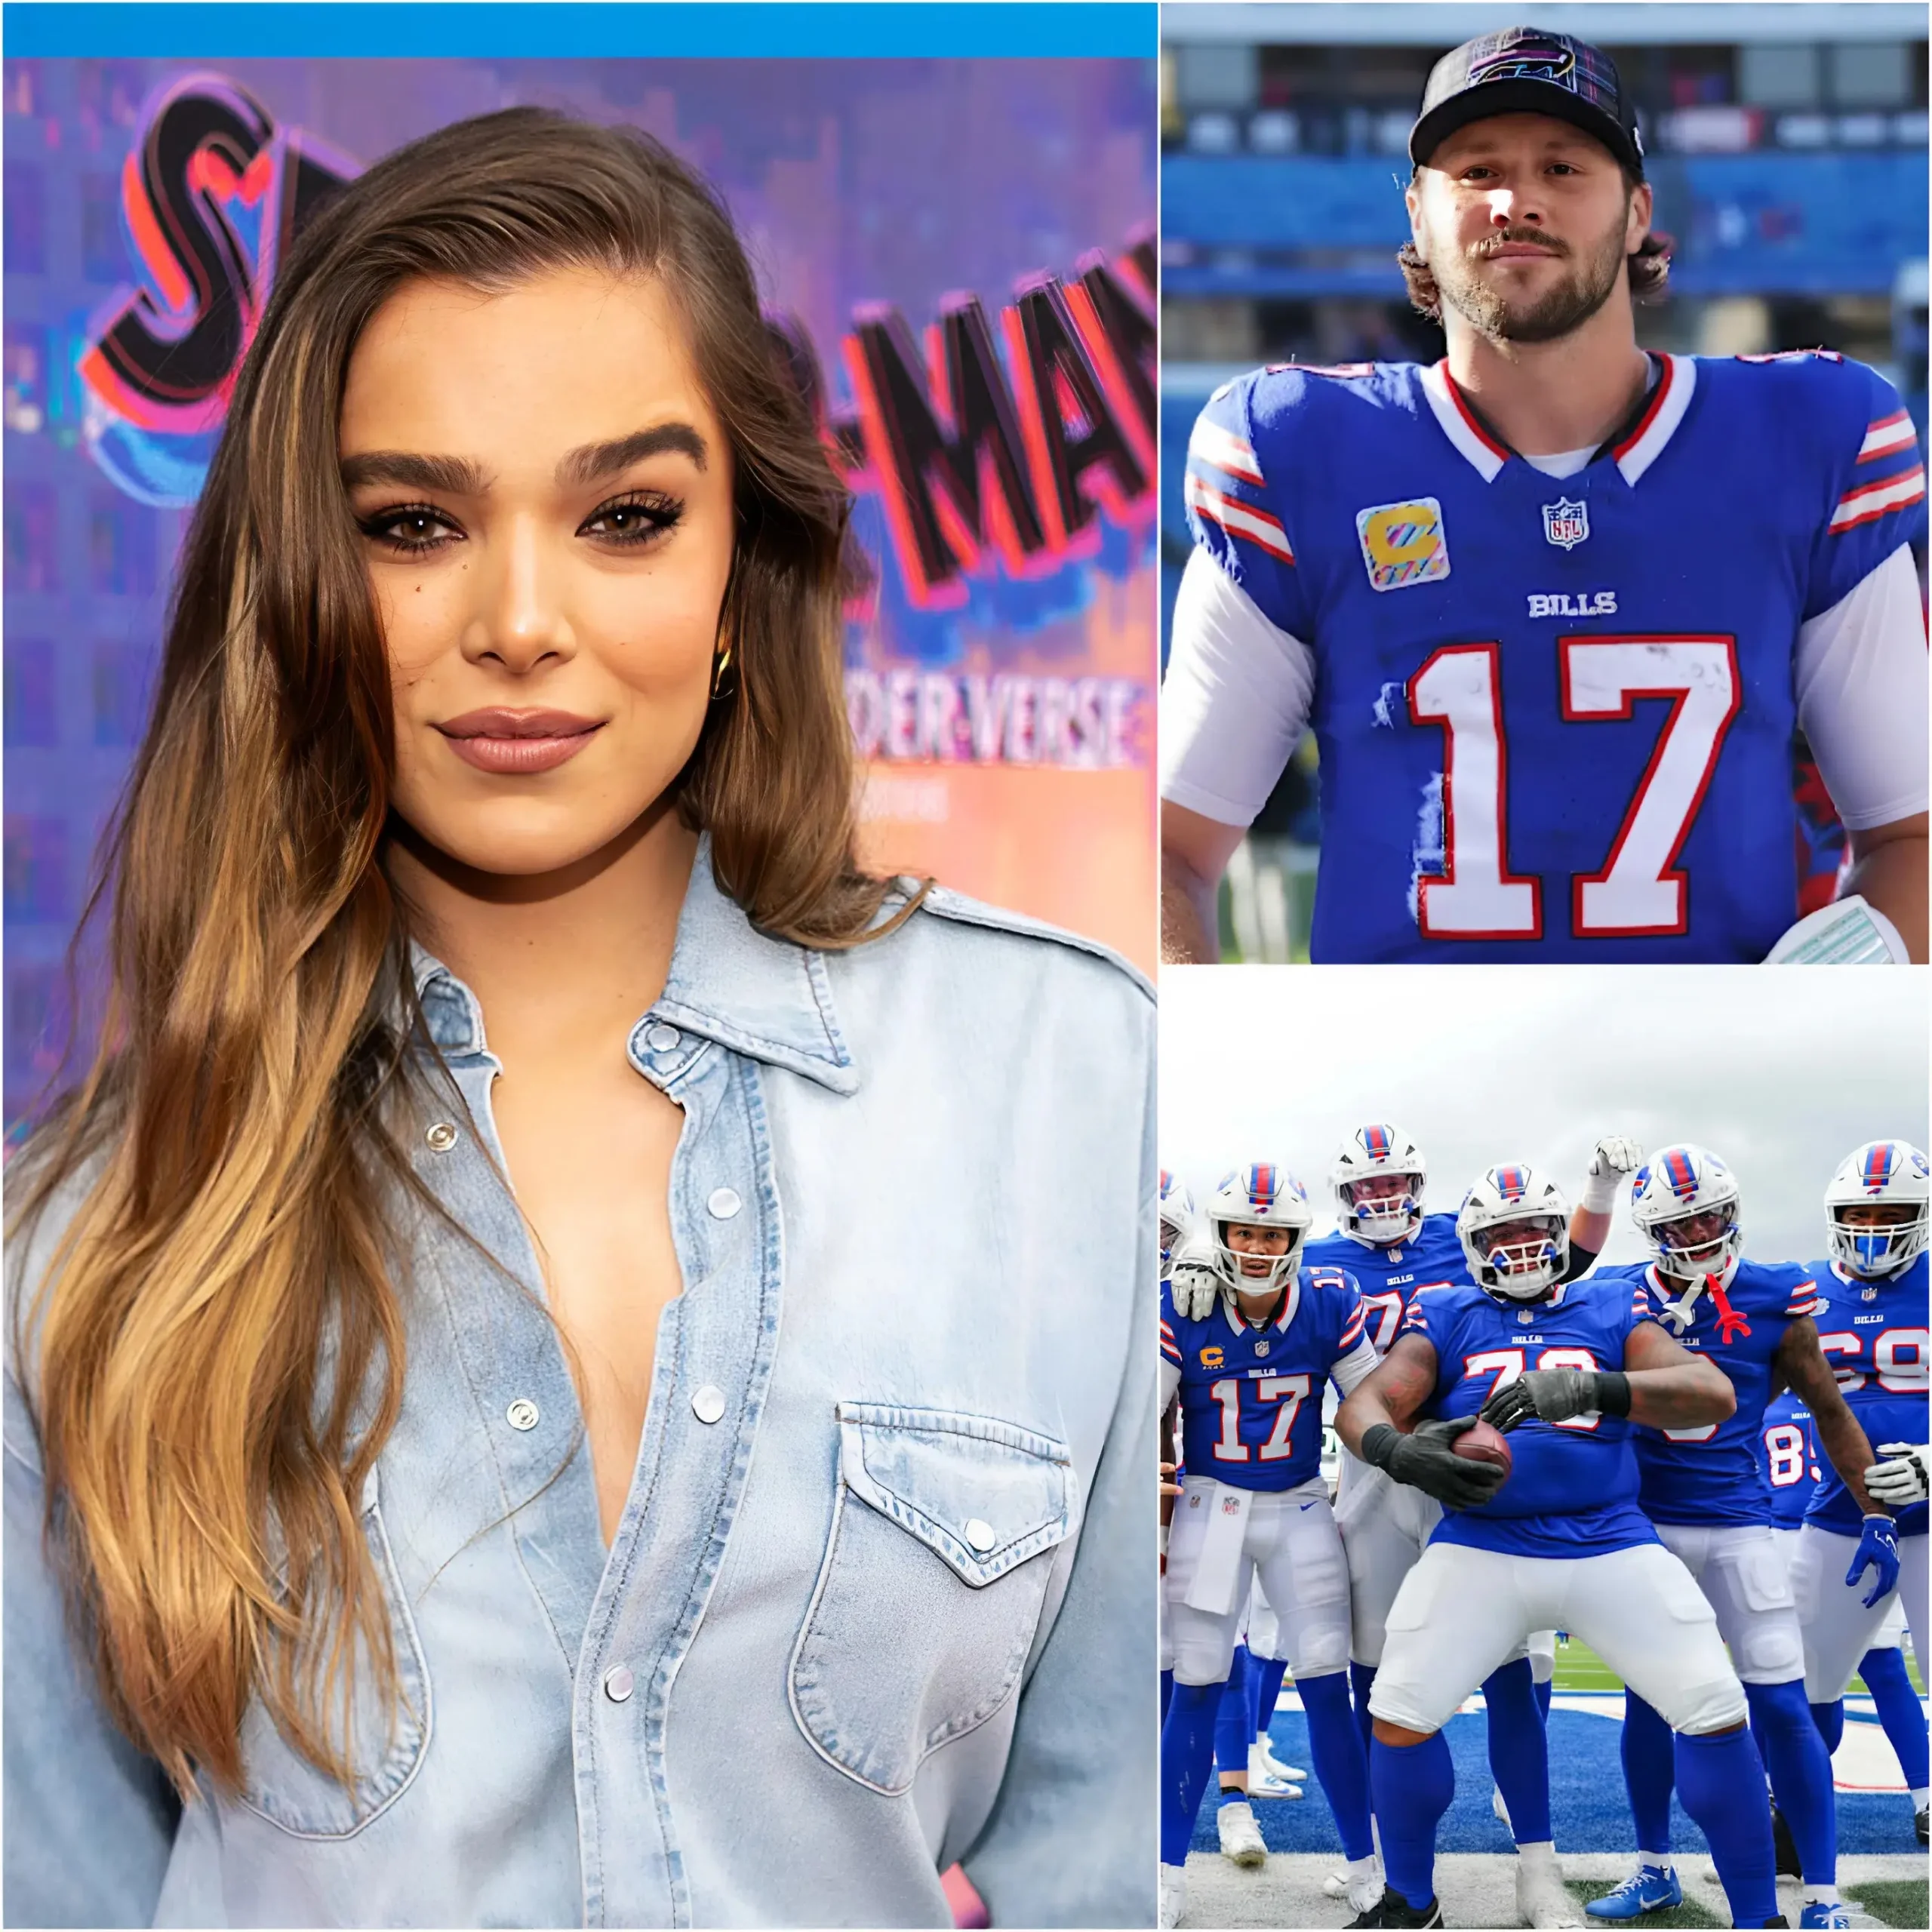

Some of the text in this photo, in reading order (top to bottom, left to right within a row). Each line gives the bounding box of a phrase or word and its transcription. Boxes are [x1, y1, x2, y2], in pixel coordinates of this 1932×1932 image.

[1365, 505, 1442, 568] C
[1527, 592, 1619, 618] BILLS
[1404, 635, 1743, 940] 17
[1200, 1347, 1224, 1367] C
[1210, 1372, 1312, 1463] 17
